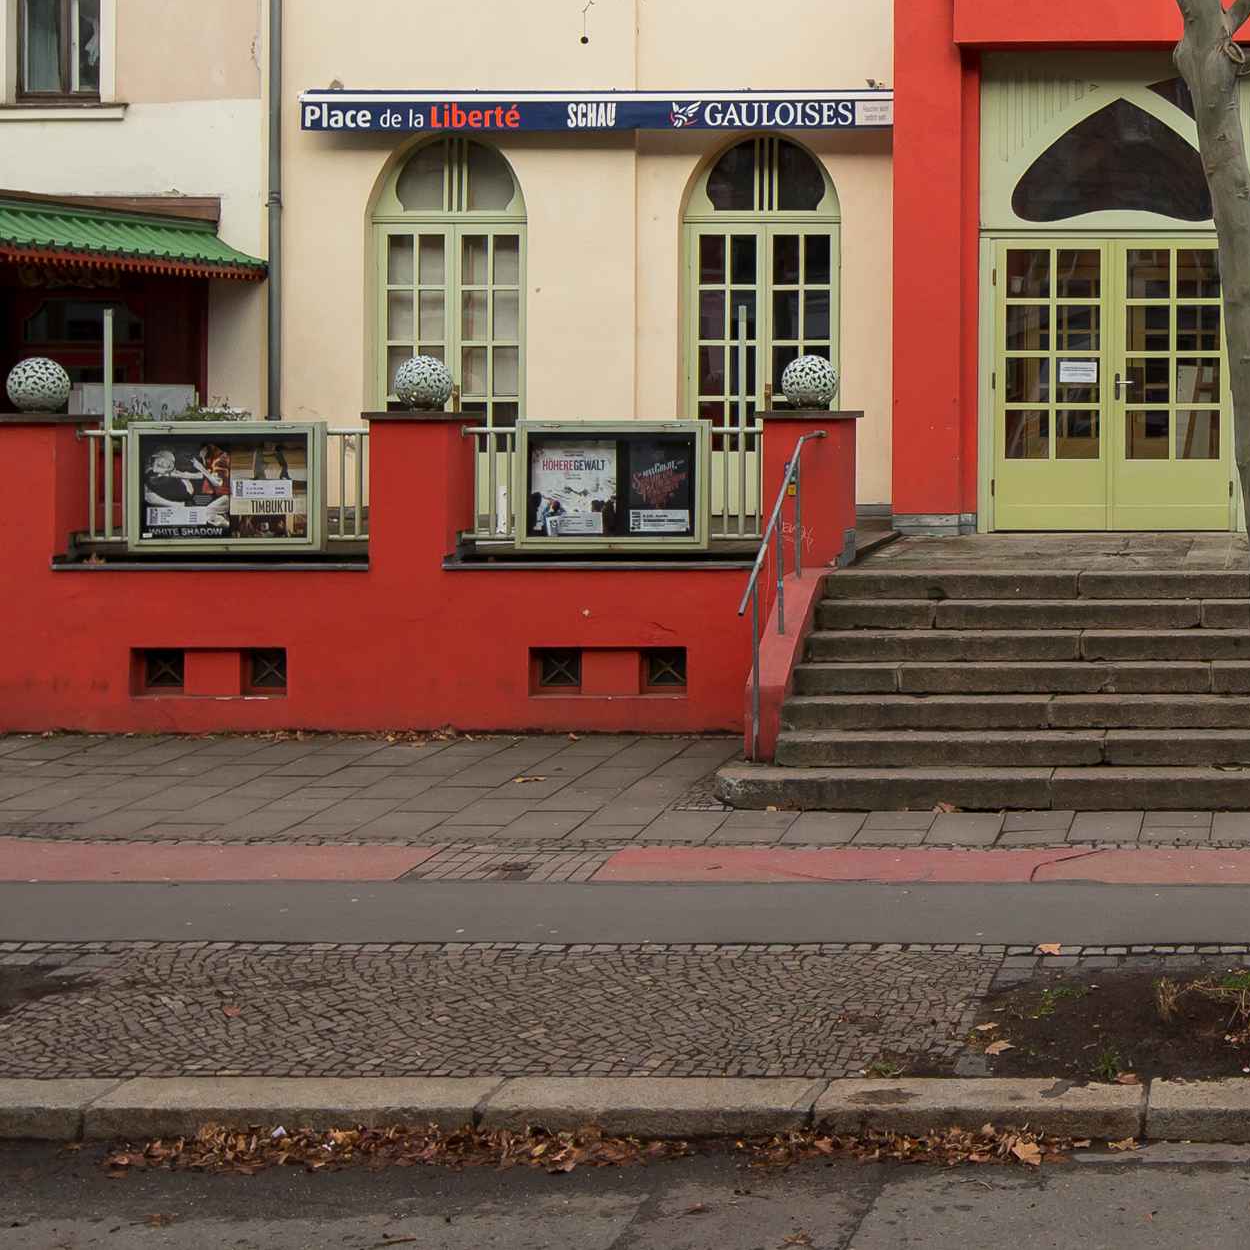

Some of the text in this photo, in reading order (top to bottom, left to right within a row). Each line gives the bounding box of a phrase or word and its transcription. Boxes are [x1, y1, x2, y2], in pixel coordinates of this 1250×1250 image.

[304, 103, 521, 128] Place de la Liberté
[566, 102, 617, 128] SCHAU
[703, 101, 853, 127] GAULOISES
[251, 499, 295, 514] TIMBUKTU
[149, 527, 224, 537] WHITE SHADOW
